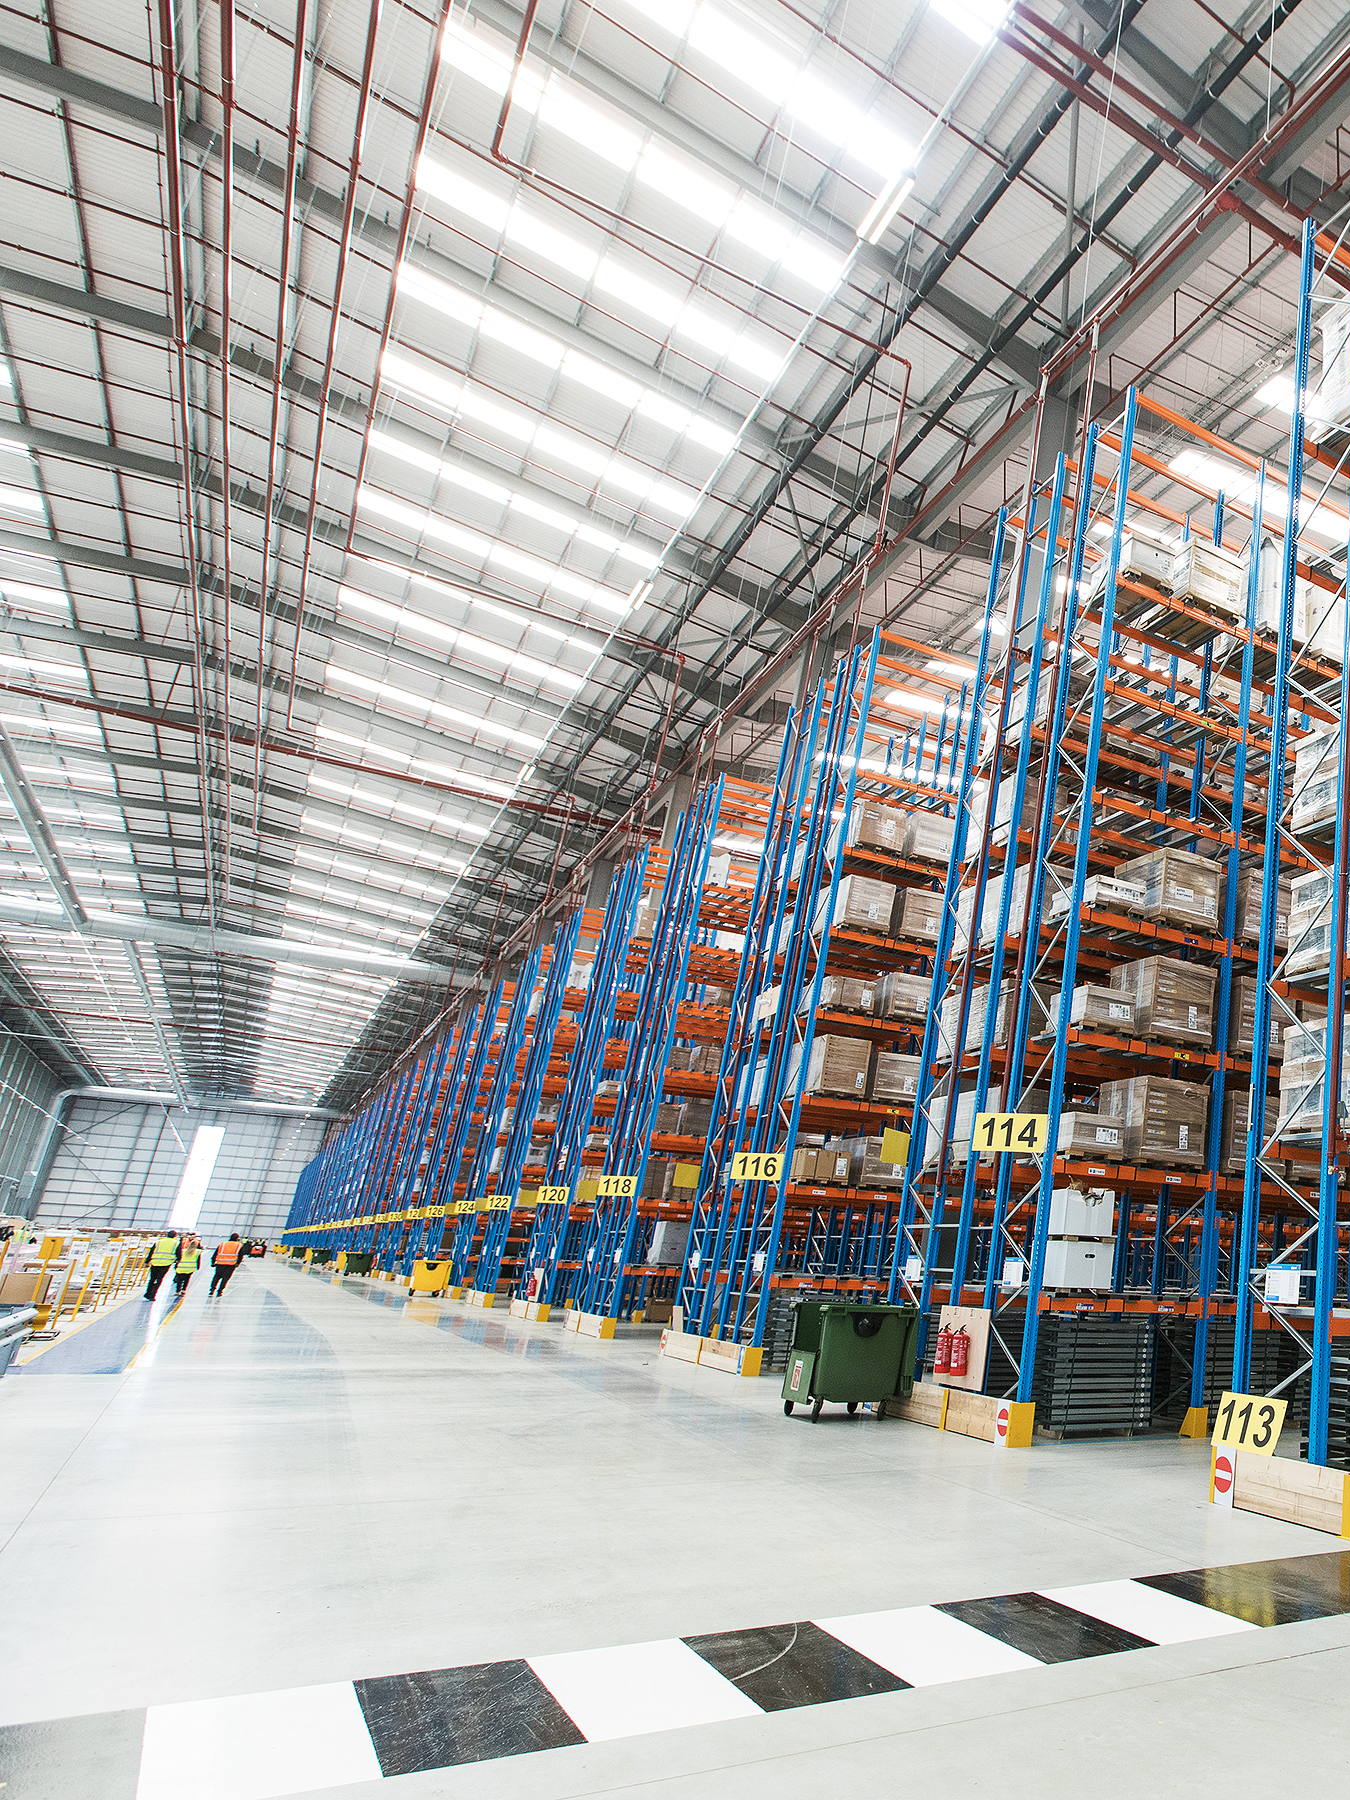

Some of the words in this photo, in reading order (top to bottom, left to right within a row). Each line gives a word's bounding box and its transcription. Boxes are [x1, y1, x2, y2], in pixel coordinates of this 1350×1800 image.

[982, 1117, 1038, 1148] 114
[737, 1156, 778, 1177] 116
[602, 1178, 631, 1194] 118
[489, 1196, 509, 1208] 122
[540, 1188, 565, 1202] 120
[428, 1206, 443, 1216] 126
[457, 1202, 475, 1211] 124
[409, 1210, 420, 1218] 12
[1221, 1399, 1276, 1448] 113
